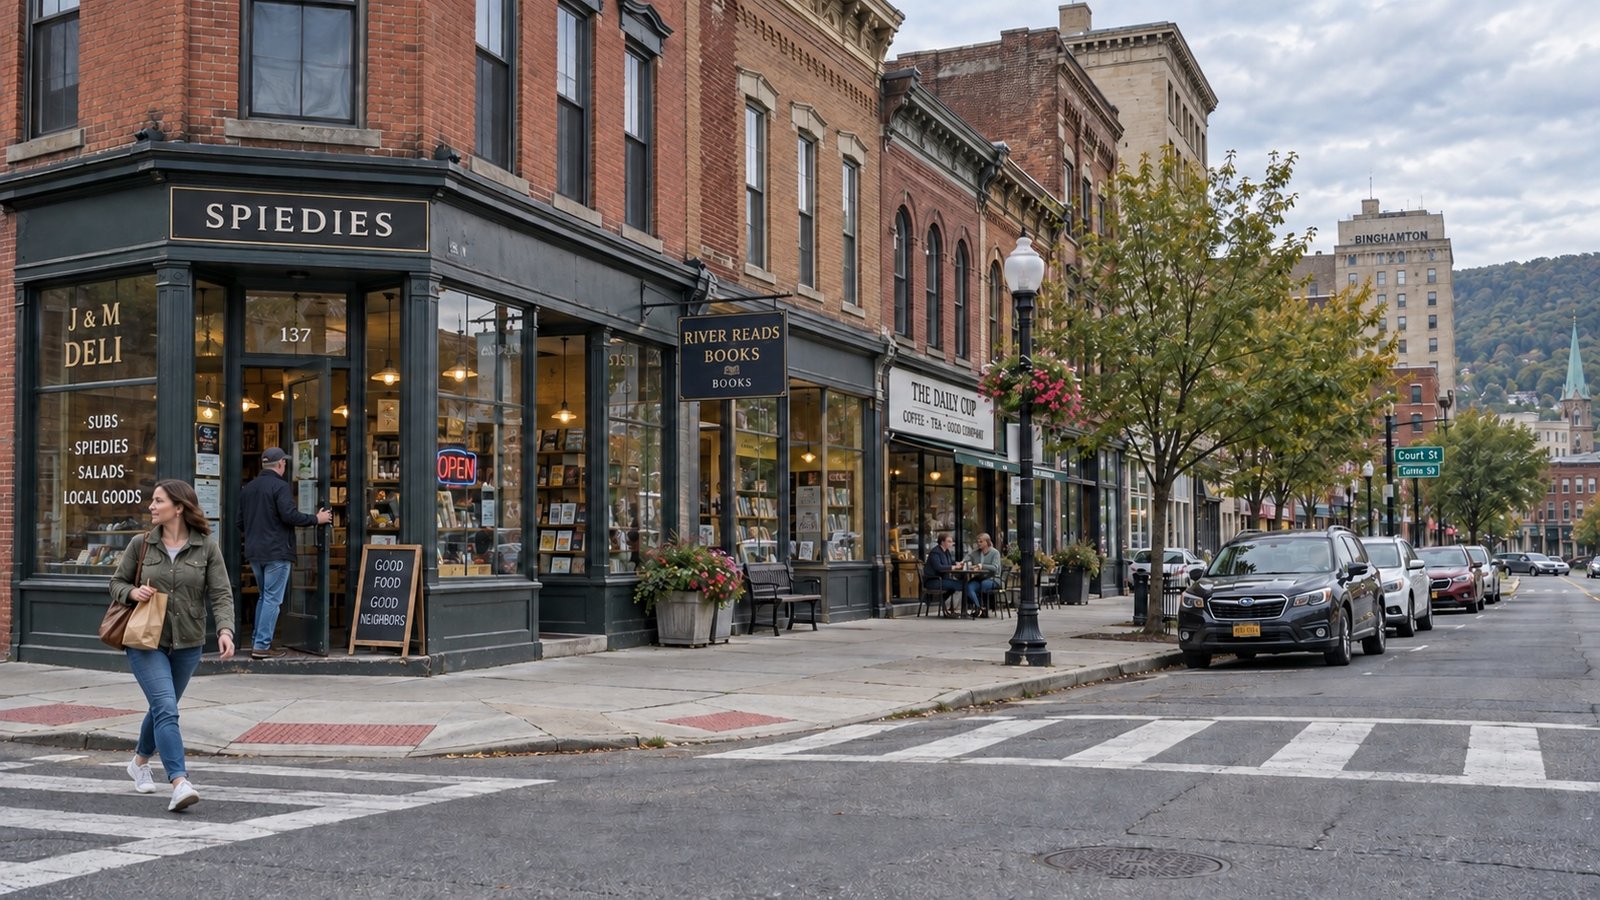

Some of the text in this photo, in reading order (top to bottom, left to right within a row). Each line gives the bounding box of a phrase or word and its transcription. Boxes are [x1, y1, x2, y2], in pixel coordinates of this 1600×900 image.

[206, 203, 393, 237] SPIEDIES
[1355, 231, 1428, 244] BINGHAMTON
[68, 302, 121, 331] J & M
[280, 327, 311, 342] 137
[684, 326, 780, 345] RIVER READS
[64, 335, 122, 368] DELI
[704, 347, 760, 363] BOOKS
[712, 377, 752, 388] BOOKS
[911, 381, 976, 417] THE DAILY CUP
[88, 413, 118, 430] SUBS
[903, 410, 924, 426] COFFEE
[931, 417, 942, 430] TEA
[75, 438, 128, 455] SPIEDIES
[1398, 450, 1438, 460] Court St
[78, 464, 124, 480] SALADS
[437, 455, 475, 480] OPEN
[64, 489, 142, 505] LOCAL GOODS
[375, 559, 404, 571] GOOD
[373, 576, 401, 588] FOOD
[370, 596, 398, 609] GOOD
[360, 613, 406, 626] NEIGHBORS
